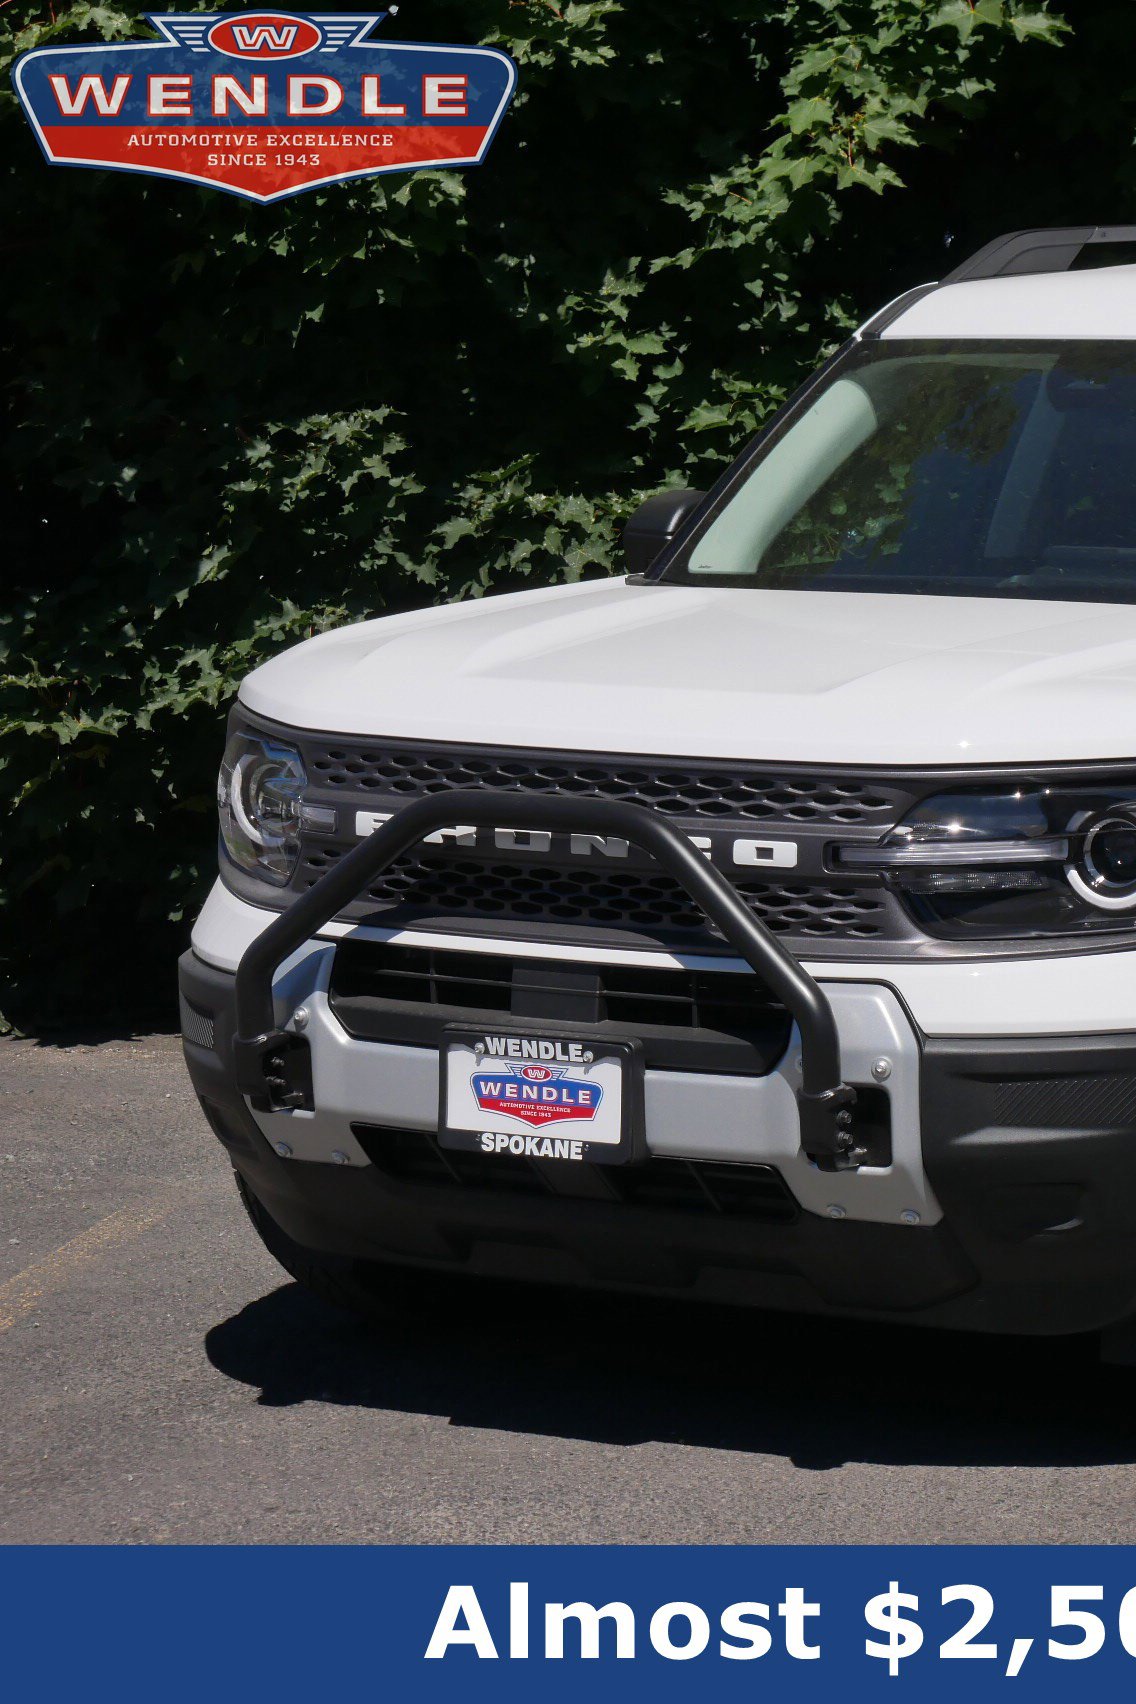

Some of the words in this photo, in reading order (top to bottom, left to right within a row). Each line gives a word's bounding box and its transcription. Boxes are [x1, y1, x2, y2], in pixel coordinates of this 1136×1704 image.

[484, 1036, 584, 1063] WENDLE
[479, 1081, 592, 1105] WENDLE
[499, 1102, 536, 1110] AUTOMOTIVE
[536, 1105, 571, 1113] EXCELLENCE
[481, 1132, 584, 1161] SPOKANE
